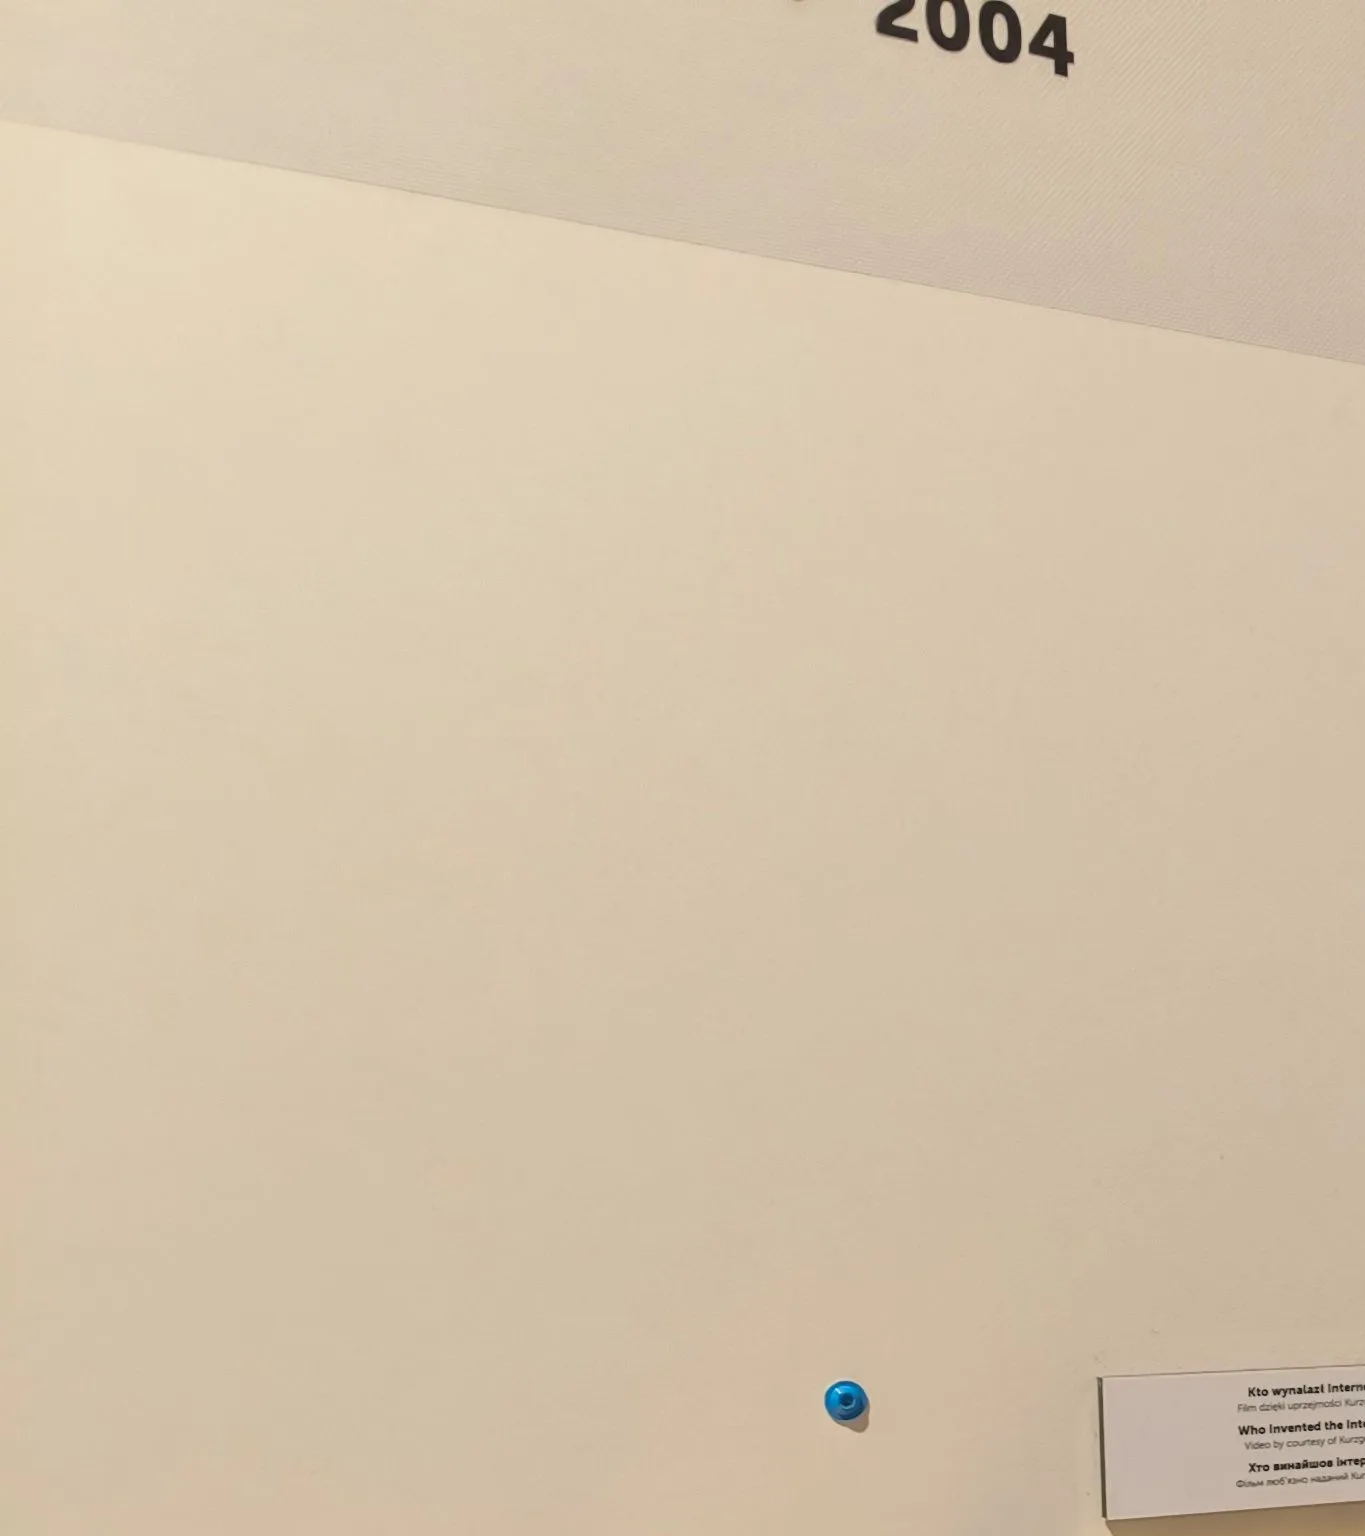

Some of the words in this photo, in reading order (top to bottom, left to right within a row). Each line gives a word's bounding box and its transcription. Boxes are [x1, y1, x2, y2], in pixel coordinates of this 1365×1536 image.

[876, 0, 1075, 77] 2004
[1248, 1386, 1269, 1397] Kto
[1238, 1425, 1266, 1436] Who
[1269, 1421, 1321, 1434] Invented
[1324, 1420, 1343, 1430] the
[1244, 1441, 1271, 1450] Video
[1273, 1440, 1284, 1451] by
[1286, 1438, 1325, 1448] courtesy
[1248, 1462, 1270, 1473] Хто
